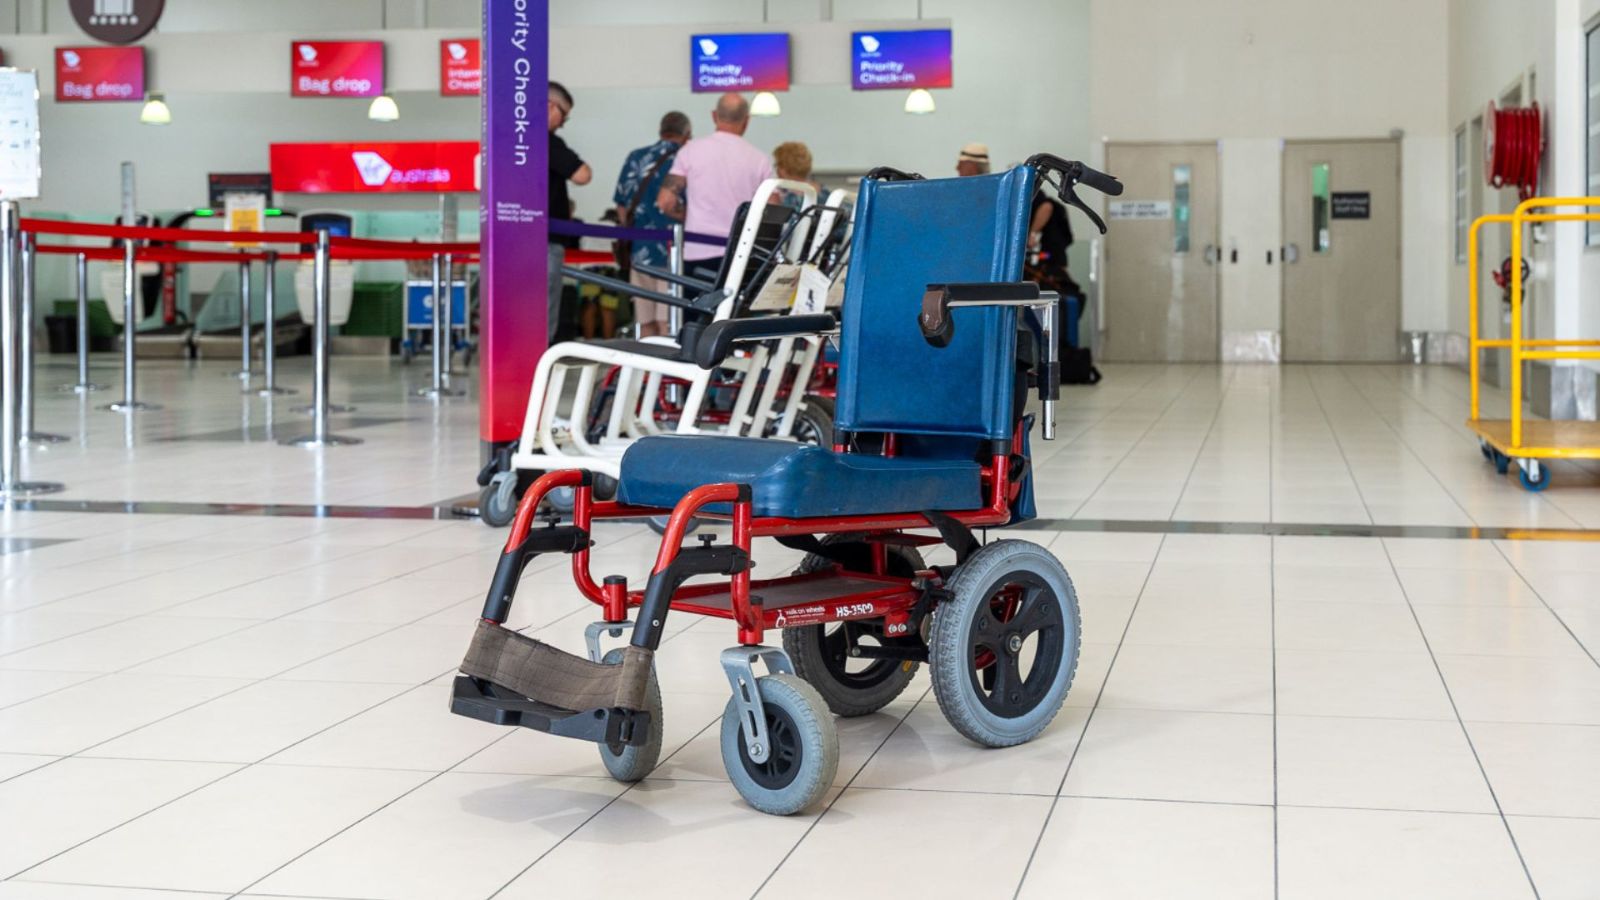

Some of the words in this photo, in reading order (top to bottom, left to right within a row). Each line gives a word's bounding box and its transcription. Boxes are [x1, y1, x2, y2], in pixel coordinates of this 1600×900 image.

[699, 64, 742, 76] Priority
[860, 61, 904, 73] Priority
[699, 75, 753, 87] Check-in
[860, 72, 916, 84] Check-in
[63, 81, 93, 99] Bag
[95, 80, 133, 98] drop
[298, 76, 330, 94] Bag
[332, 76, 371, 94] drop
[514, 58, 531, 165] Check-in
[497, 201, 521, 209] Business
